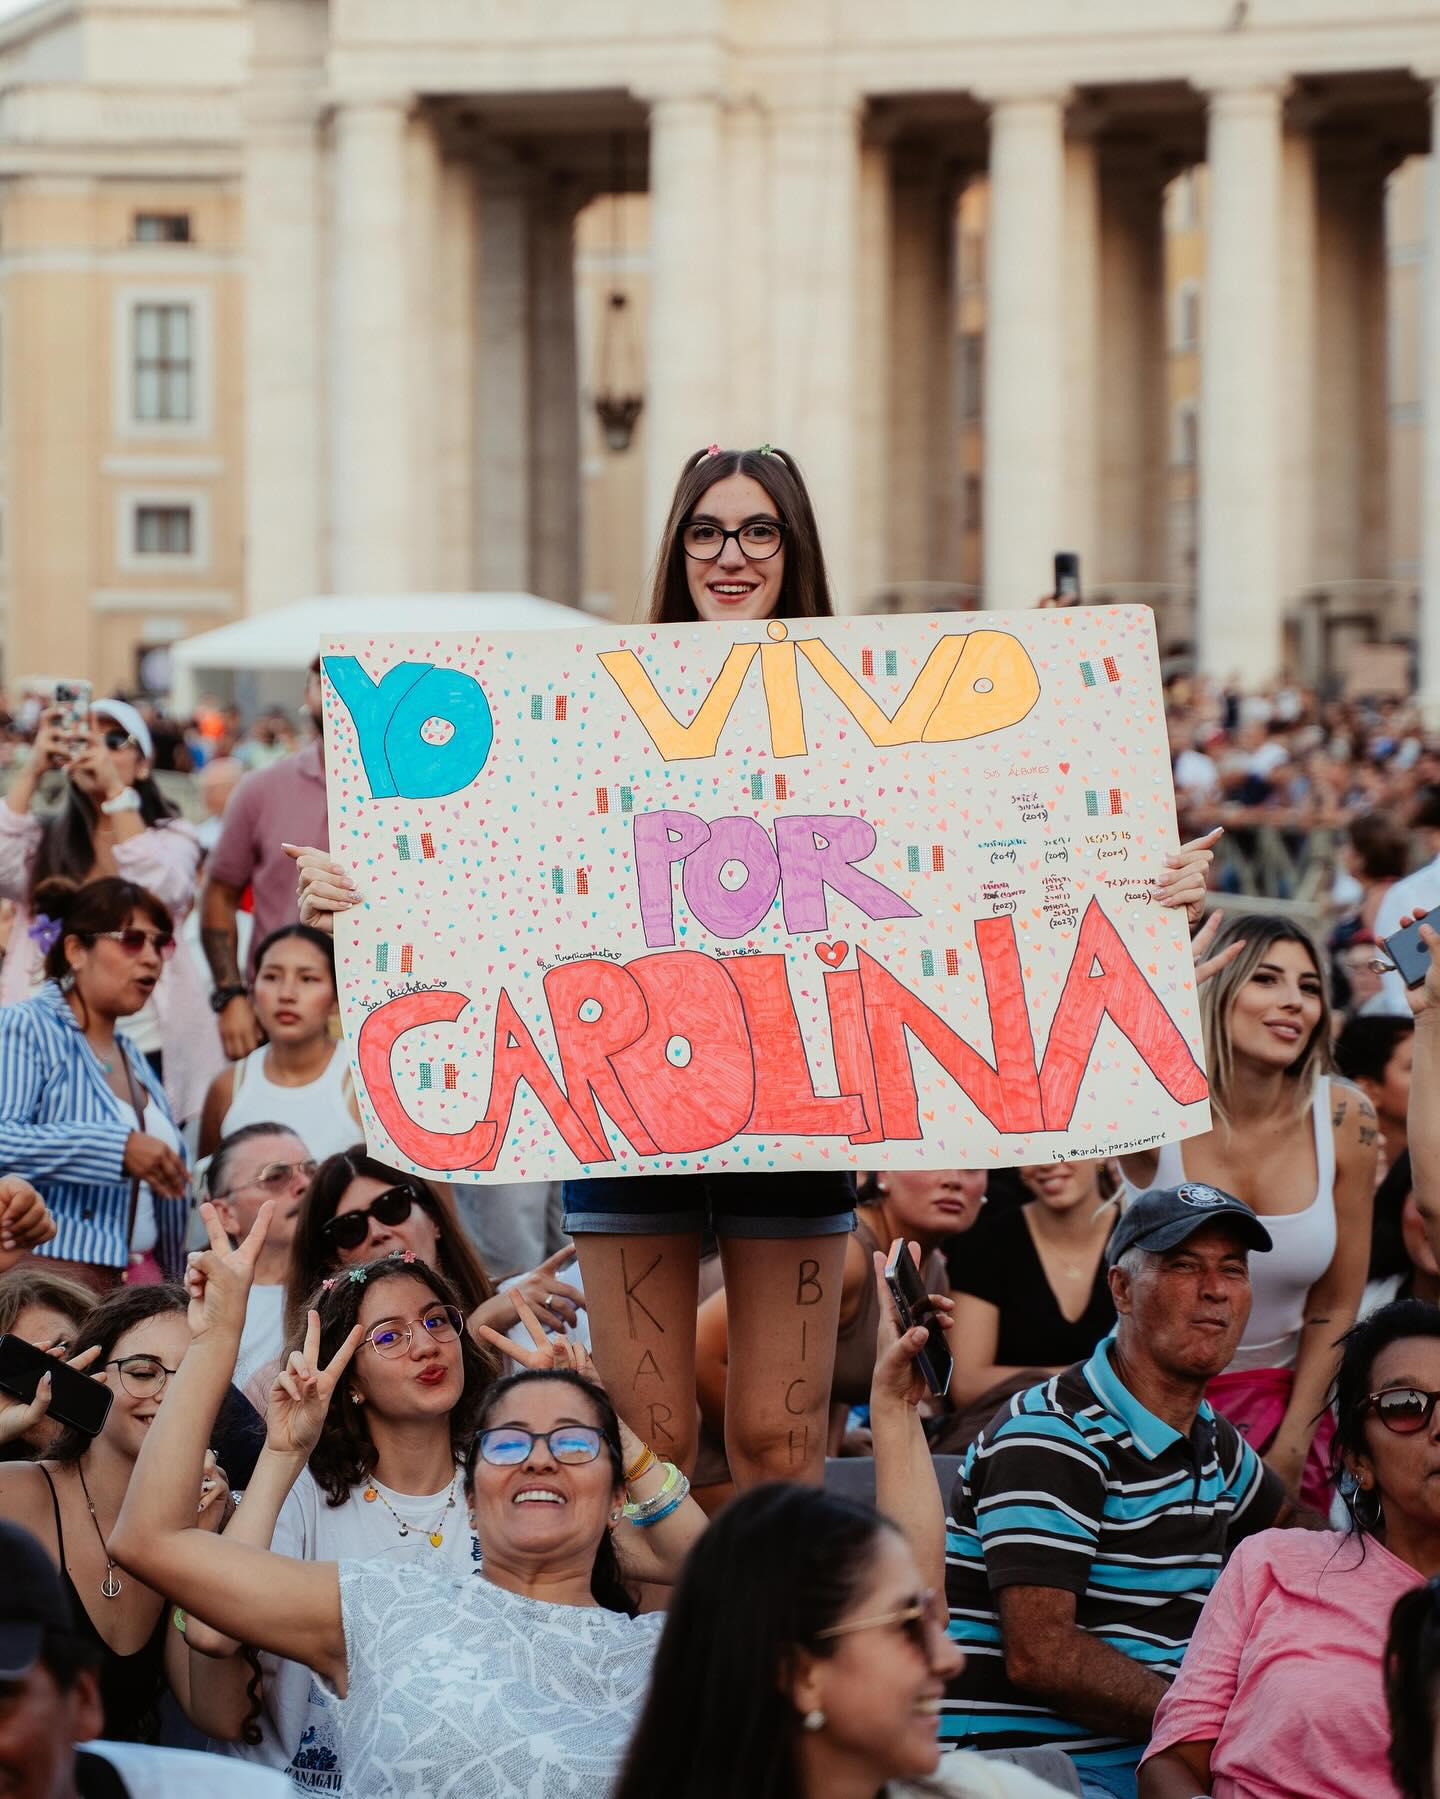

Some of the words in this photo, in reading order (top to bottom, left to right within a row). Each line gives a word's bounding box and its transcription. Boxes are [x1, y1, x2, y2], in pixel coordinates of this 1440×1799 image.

[322, 656, 494, 800] YO
[633, 810, 923, 948] POR
[1049, 916, 1077, 930] (2023)
[1124, 889, 1152, 905] (2025)
[619, 1247, 675, 1463] KAR
